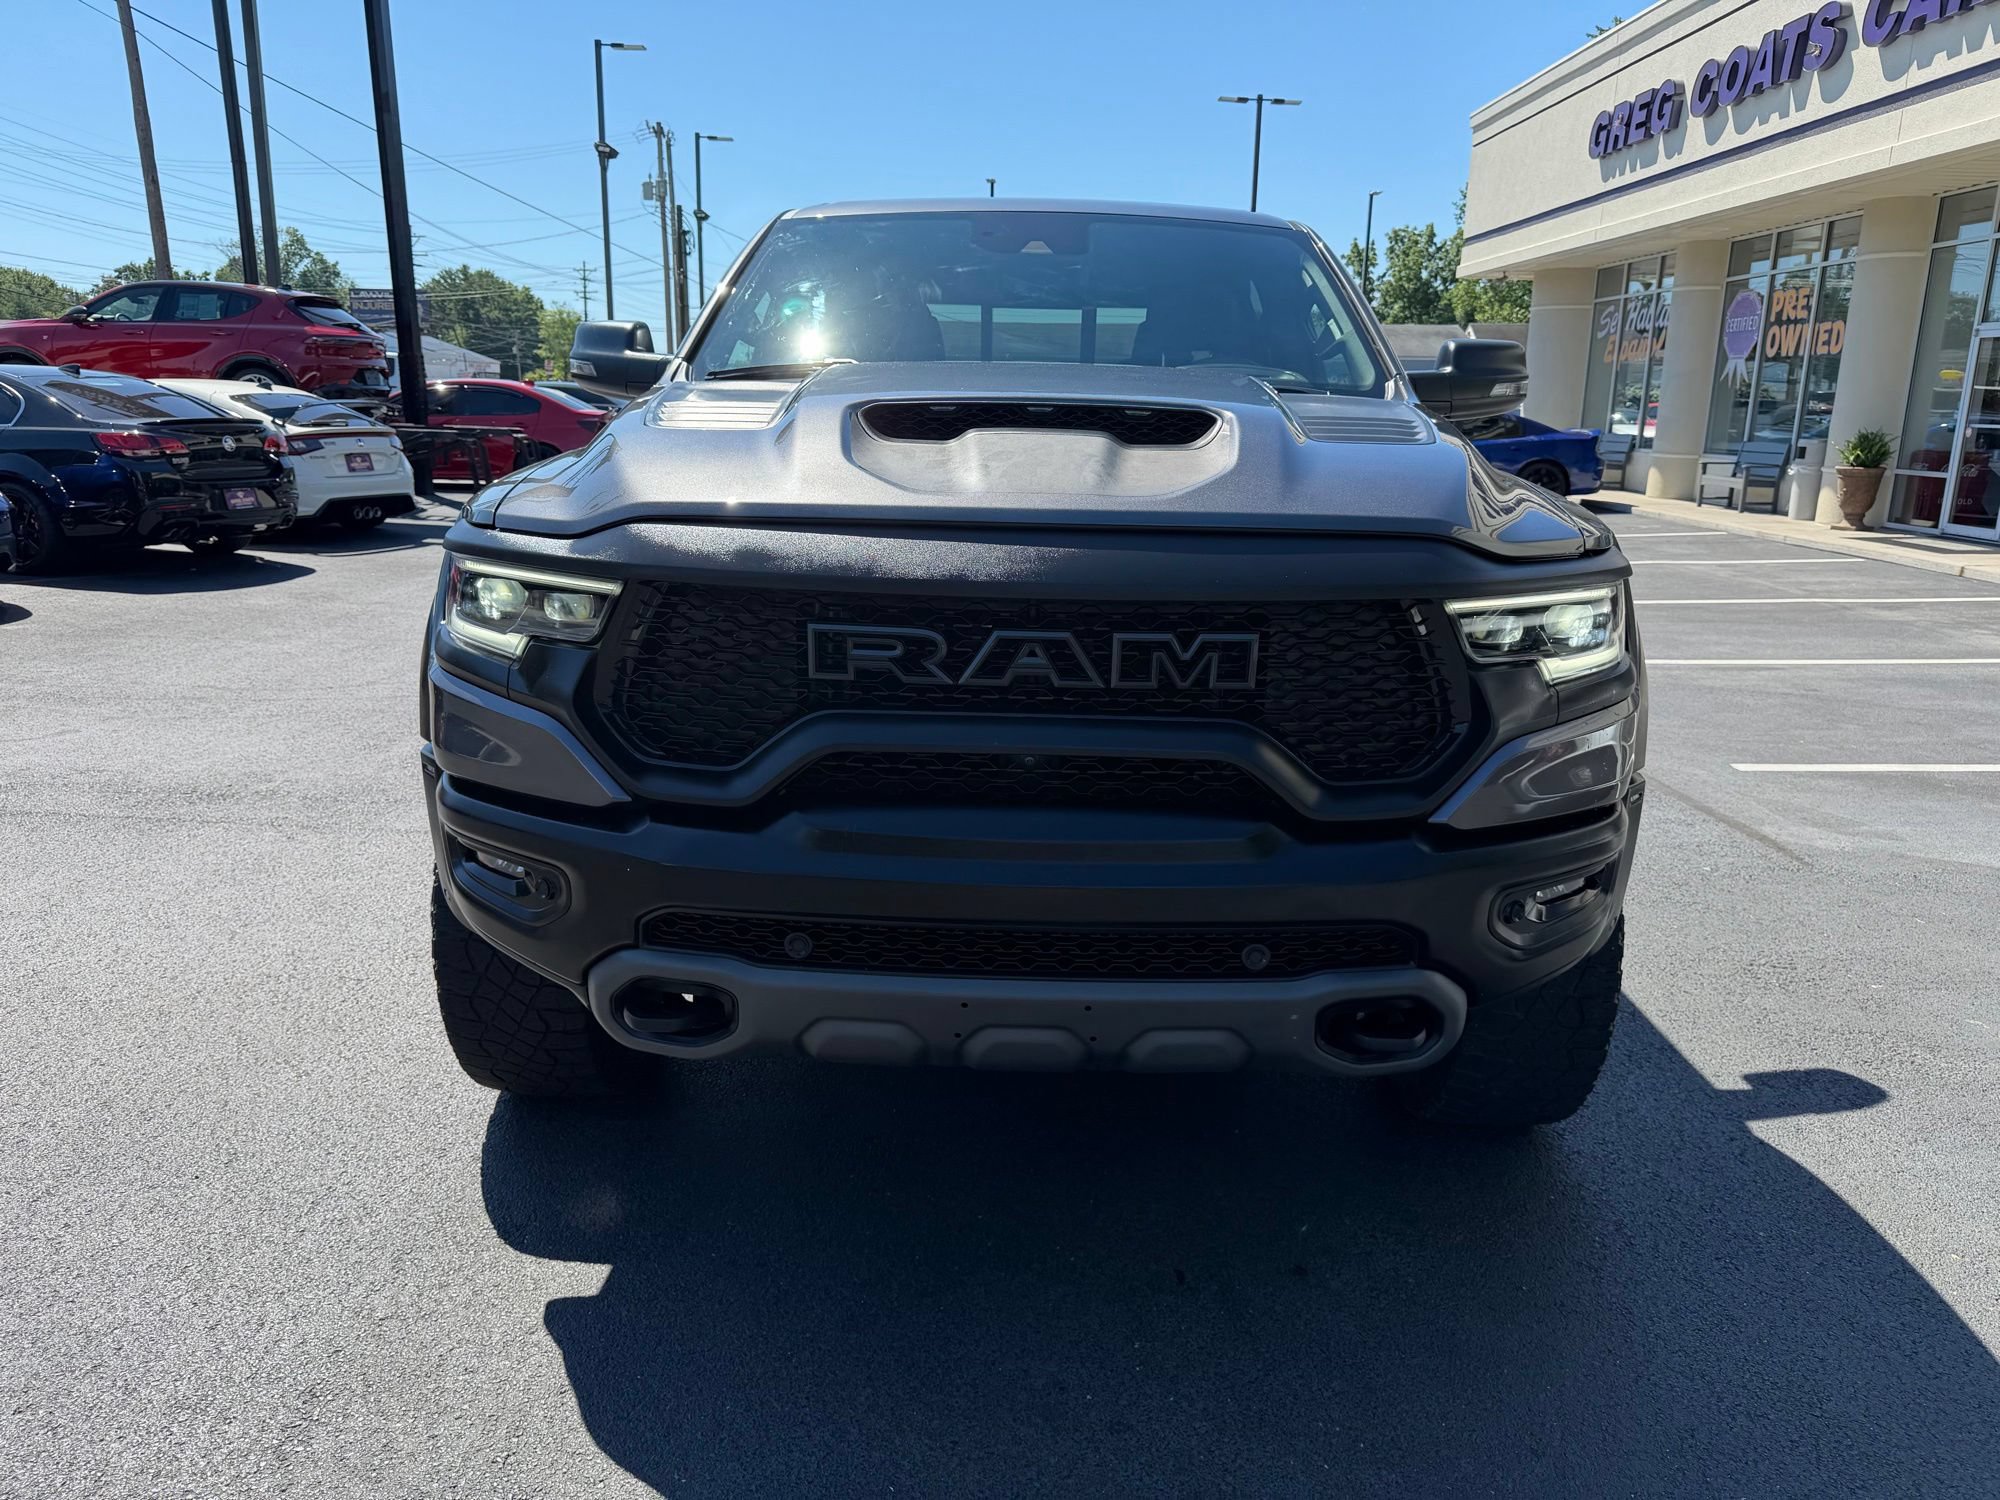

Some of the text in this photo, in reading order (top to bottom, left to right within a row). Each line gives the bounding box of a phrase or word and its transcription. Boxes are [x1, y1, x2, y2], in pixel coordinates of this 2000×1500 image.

[1589, 79, 1683, 159] GREG
[1690, 1, 1850, 118] COATS
[1597, 305, 1619, 339] Se
[1725, 315, 1760, 334] CERTIFIED
[1765, 320, 1845, 358] OWNED
[806, 622, 1260, 690] RAM
